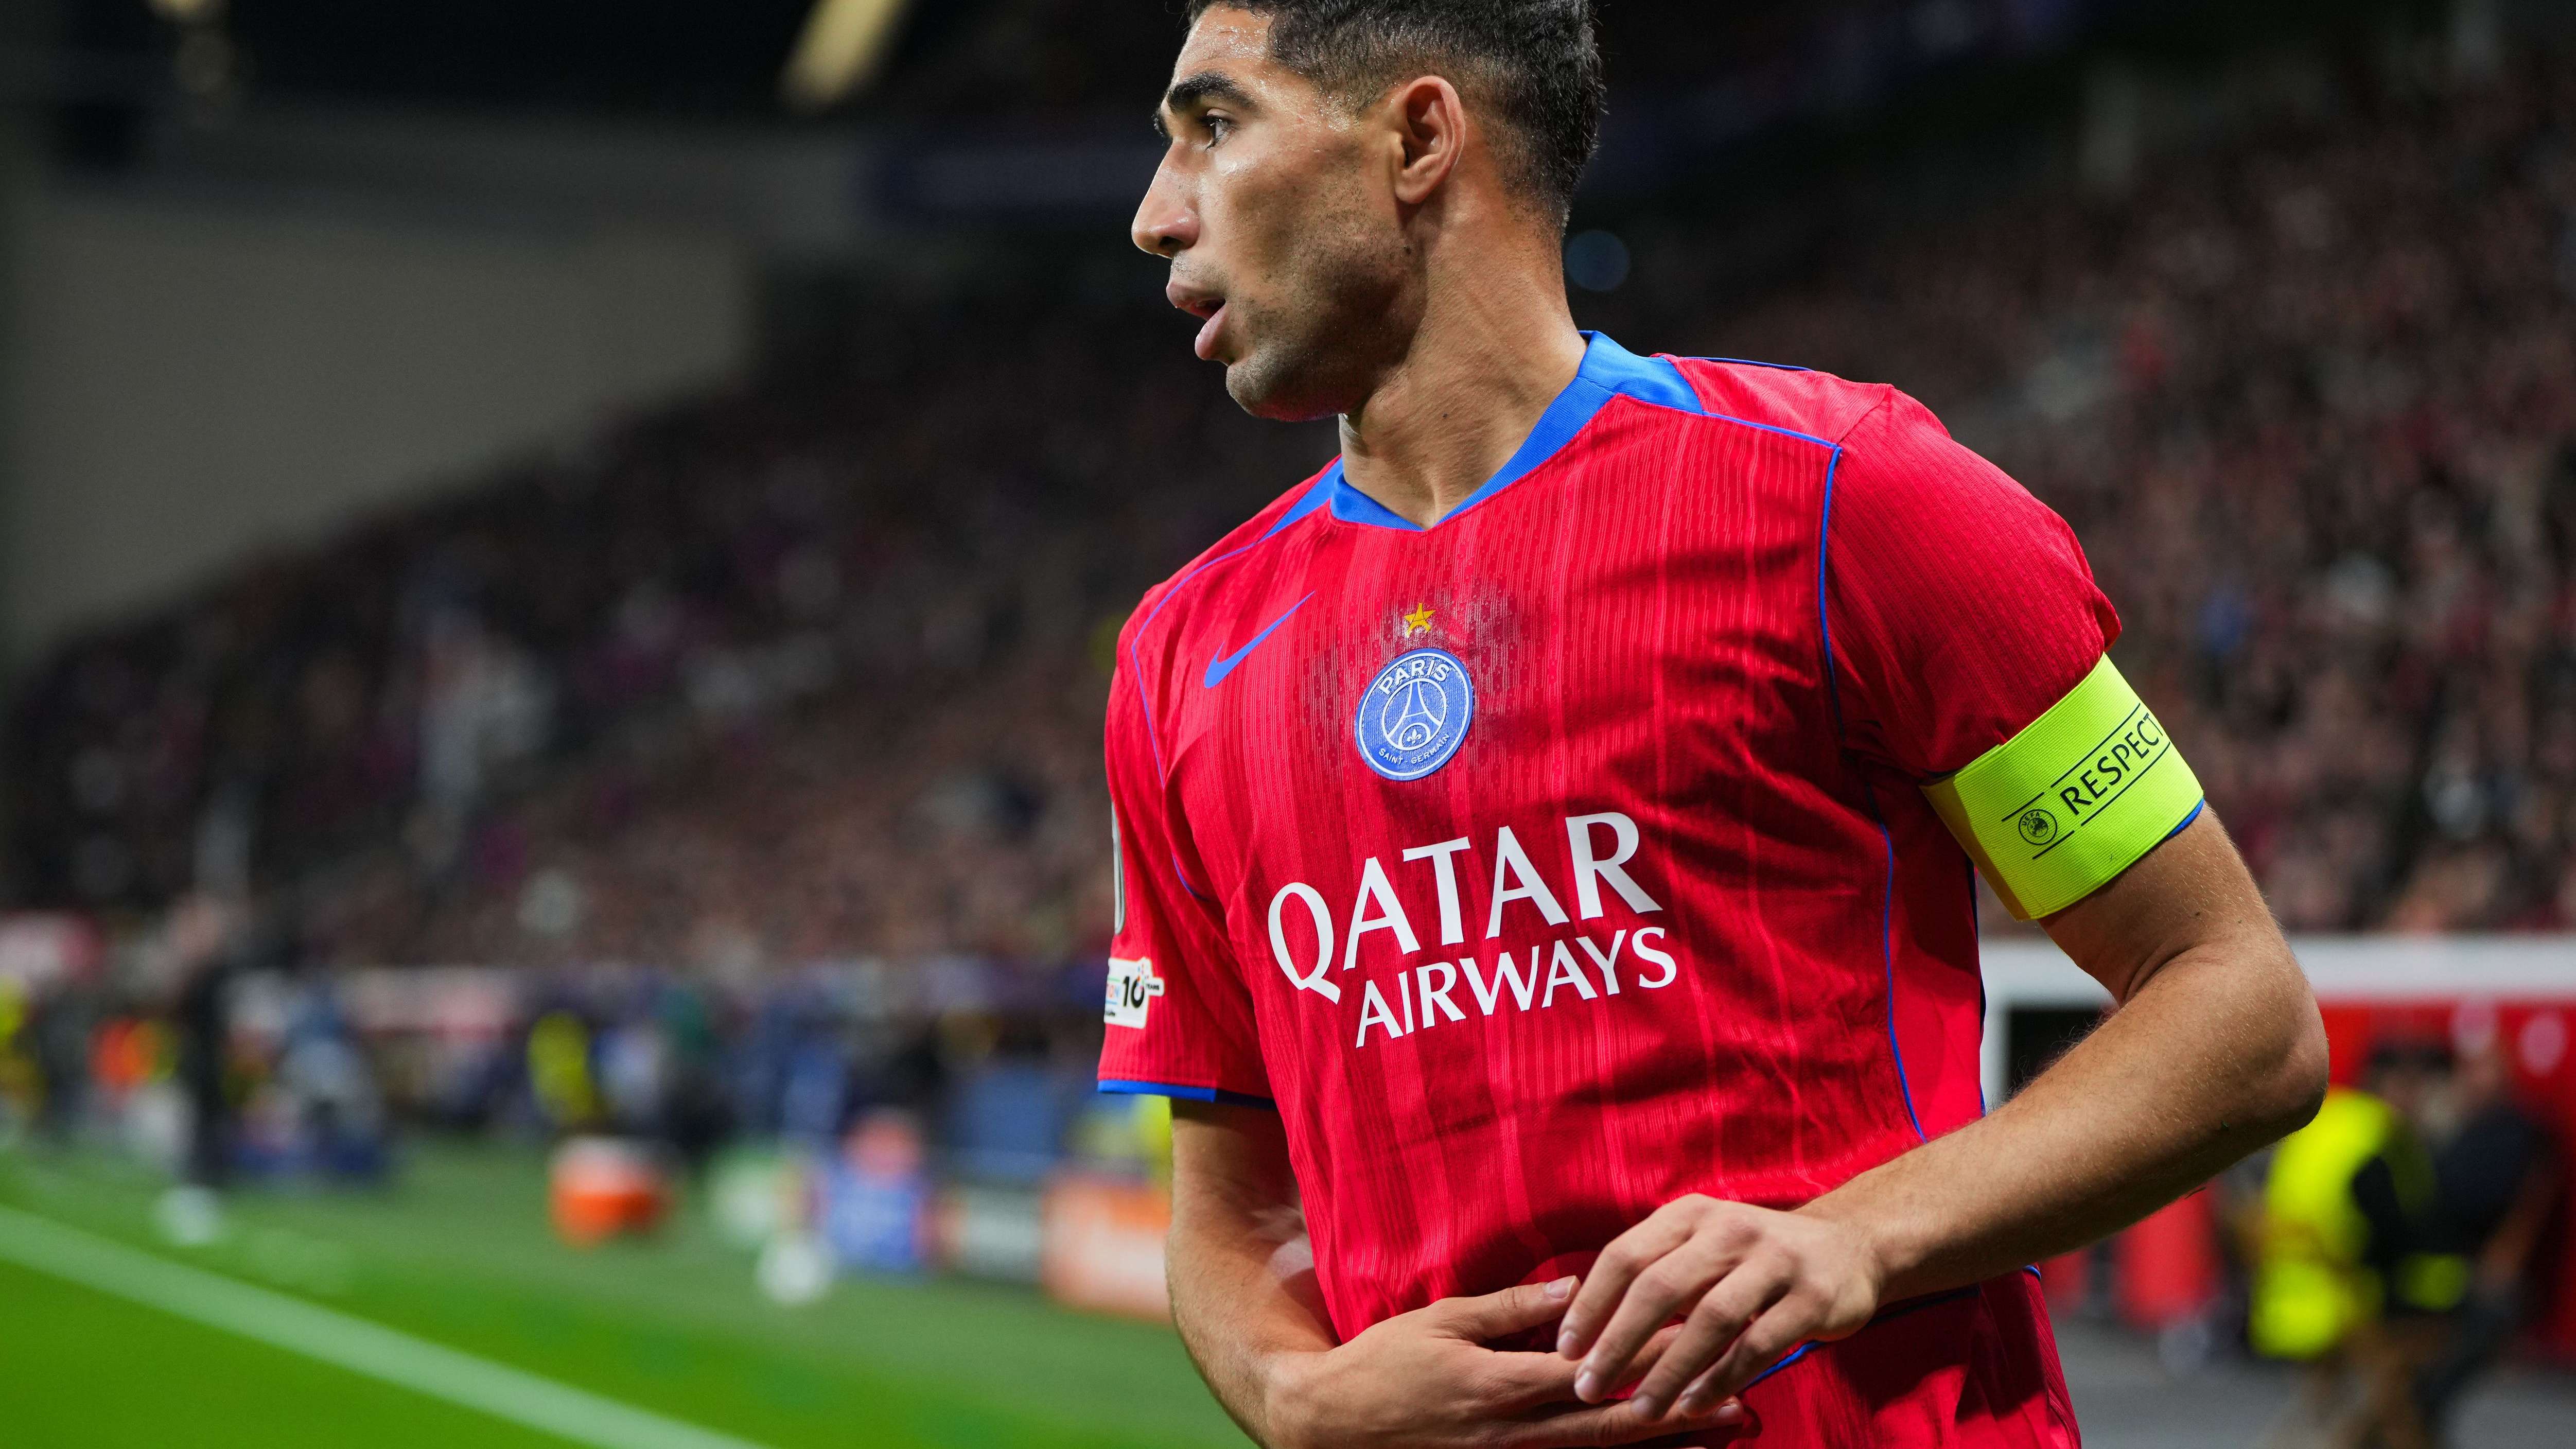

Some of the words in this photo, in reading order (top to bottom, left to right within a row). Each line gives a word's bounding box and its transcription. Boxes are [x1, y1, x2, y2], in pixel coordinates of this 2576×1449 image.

[1379, 659, 1450, 695] PARIS
[1378, 748, 1404, 765] SAINT
[1411, 733, 1450, 764] GERMAIN
[2060, 712, 2163, 816] RESPECT
[2022, 811, 2040, 826] UEFA
[1268, 812, 1663, 1005] QATAR
[1122, 975, 1145, 1009] 10
[1356, 927, 1677, 1048] AIRWAYS
